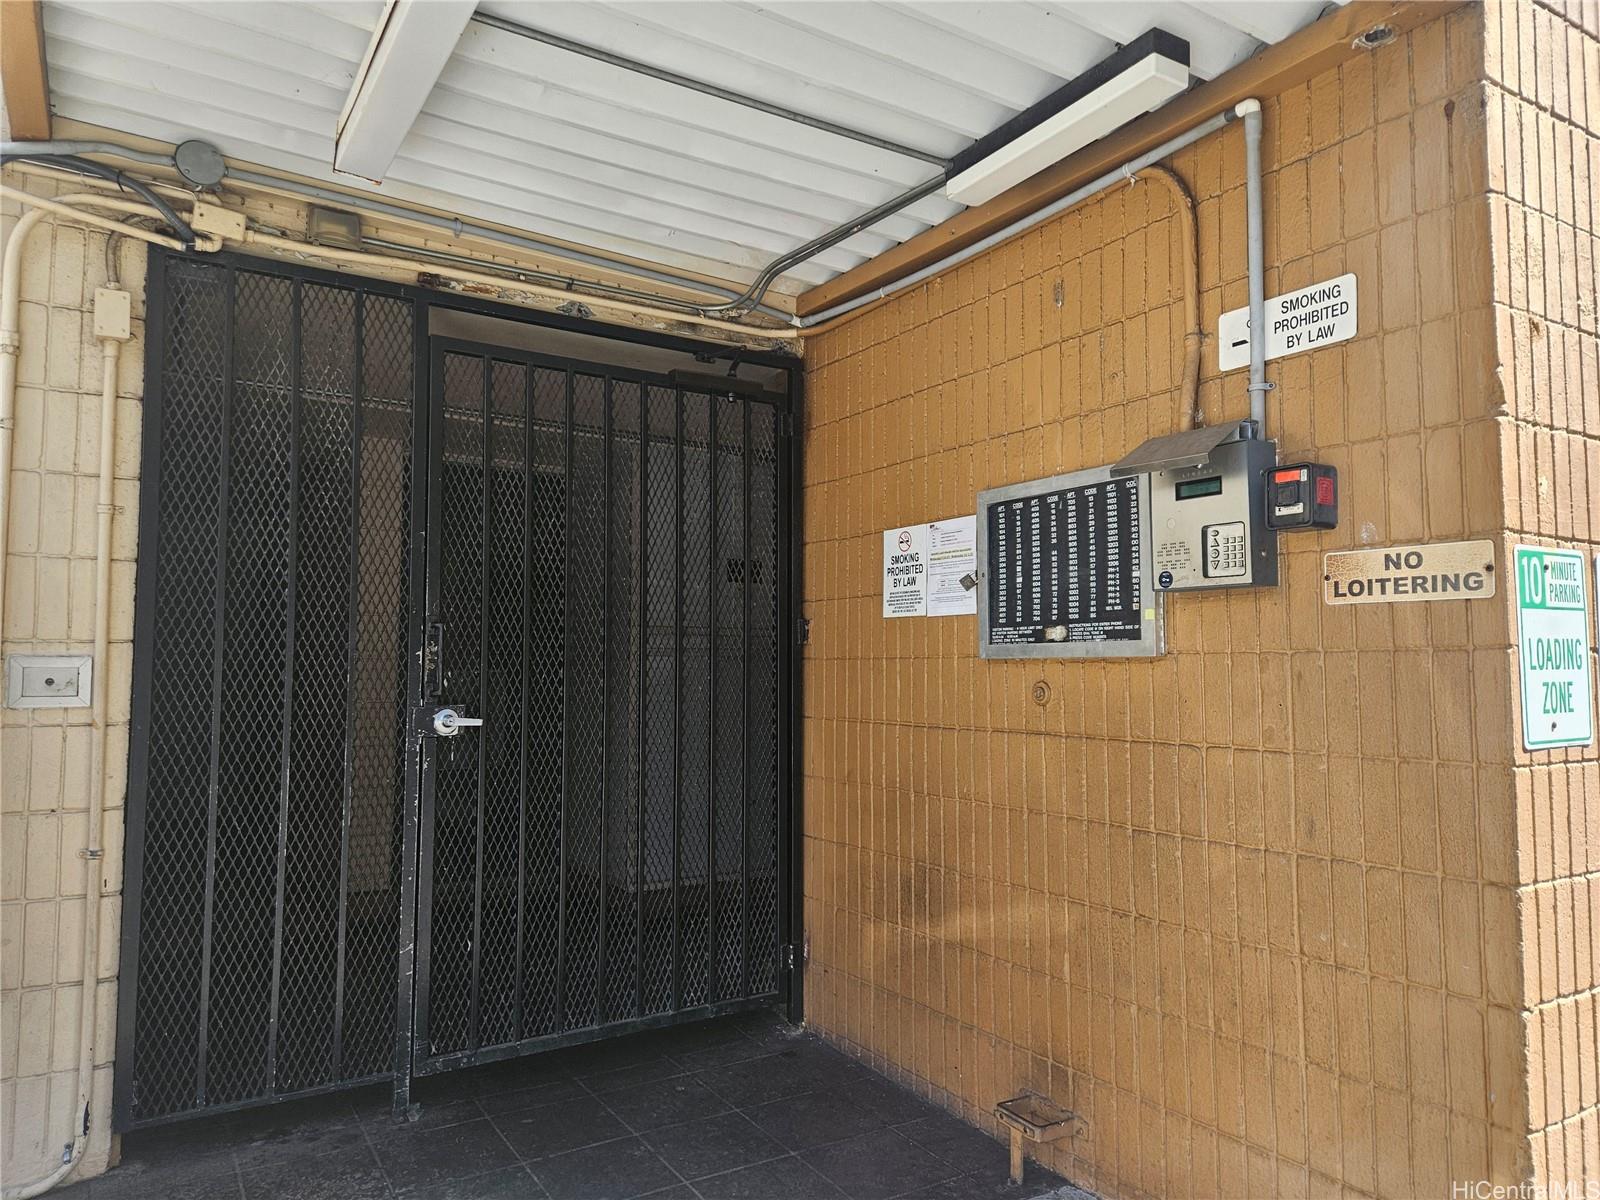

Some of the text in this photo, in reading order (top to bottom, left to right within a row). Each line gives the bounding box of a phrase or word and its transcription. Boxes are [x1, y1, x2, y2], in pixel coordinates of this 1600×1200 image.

[1281, 284, 1341, 314] SMOKING
[1274, 301, 1349, 334] PROHIBITED
[1286, 323, 1335, 348] BY LAW
[887, 563, 924, 577] PROHIBITED
[891, 552, 920, 565] SMOKING
[1384, 551, 1423, 571] NO
[893, 576, 916, 587] BY LAW
[1521, 556, 1542, 603] 10
[1551, 562, 1577, 581] MINUTE
[1333, 572, 1484, 598] LOITERING
[1549, 583, 1581, 604] PARKING
[1528, 637, 1582, 671] LOADING
[1542, 681, 1574, 714] ZONE
